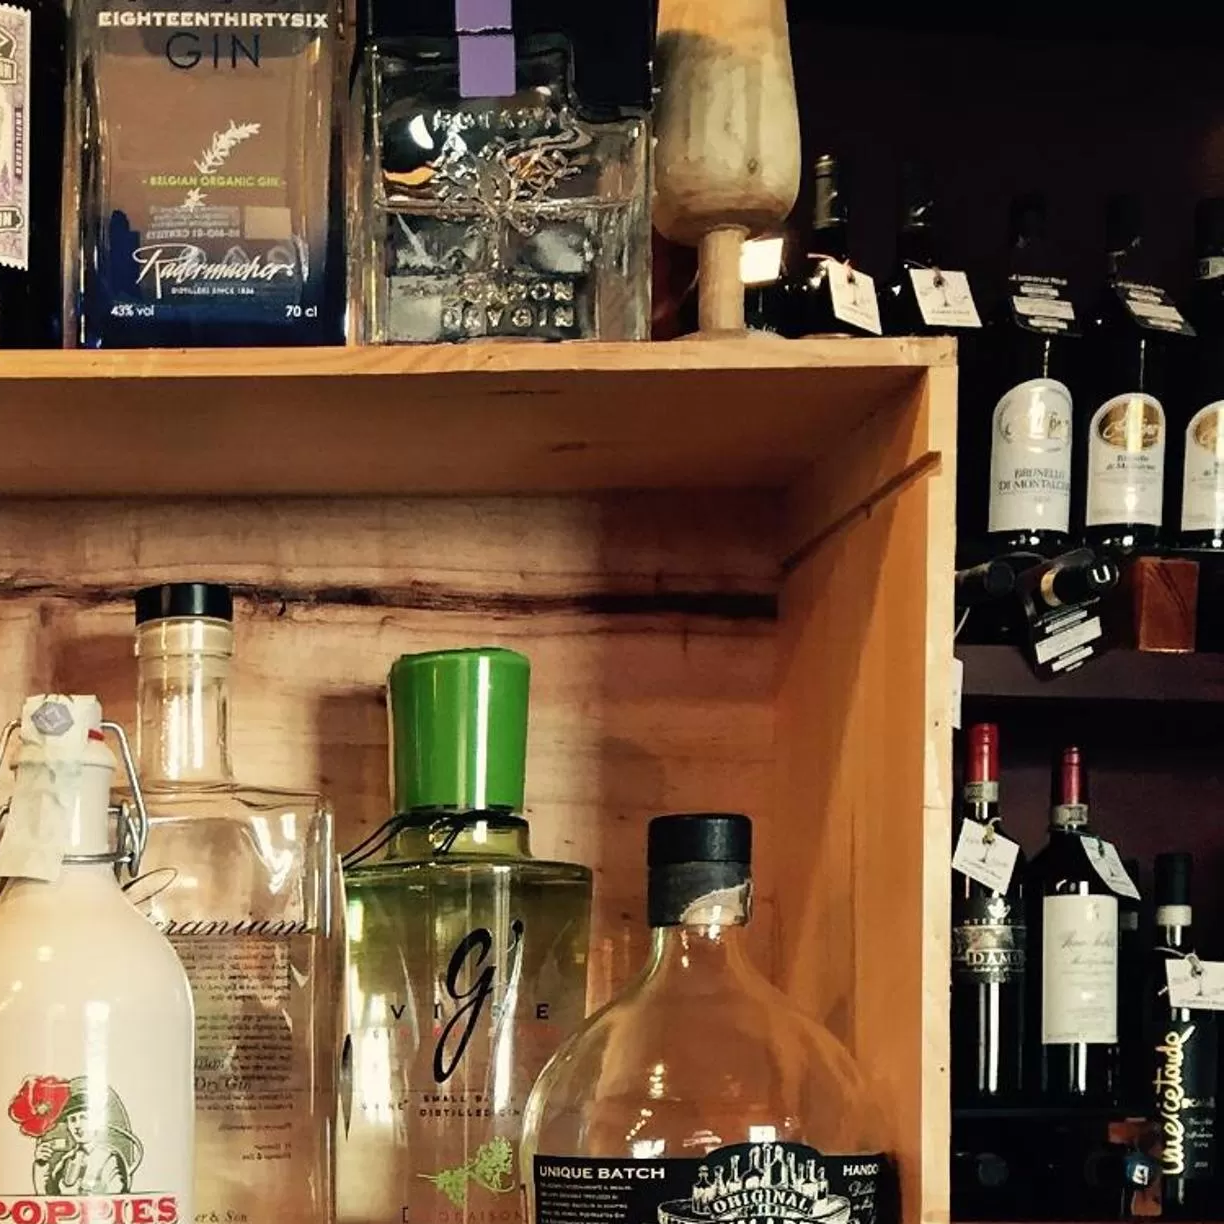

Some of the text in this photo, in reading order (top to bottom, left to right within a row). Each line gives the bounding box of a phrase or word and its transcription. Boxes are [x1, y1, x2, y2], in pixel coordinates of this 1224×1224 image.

[97, 11, 329, 28] EIGHTEENTHIRTYSIX
[165, 31, 261, 69] GIN
[149, 174, 281, 188] BELGIAN ORGANIC GIN
[110, 304, 155, 317] 43% vol
[284, 305, 318, 318] 70 cl
[538, 1164, 665, 1180] UNIQUE BATCH
[711, 1188, 813, 1218] ORIGINAL
